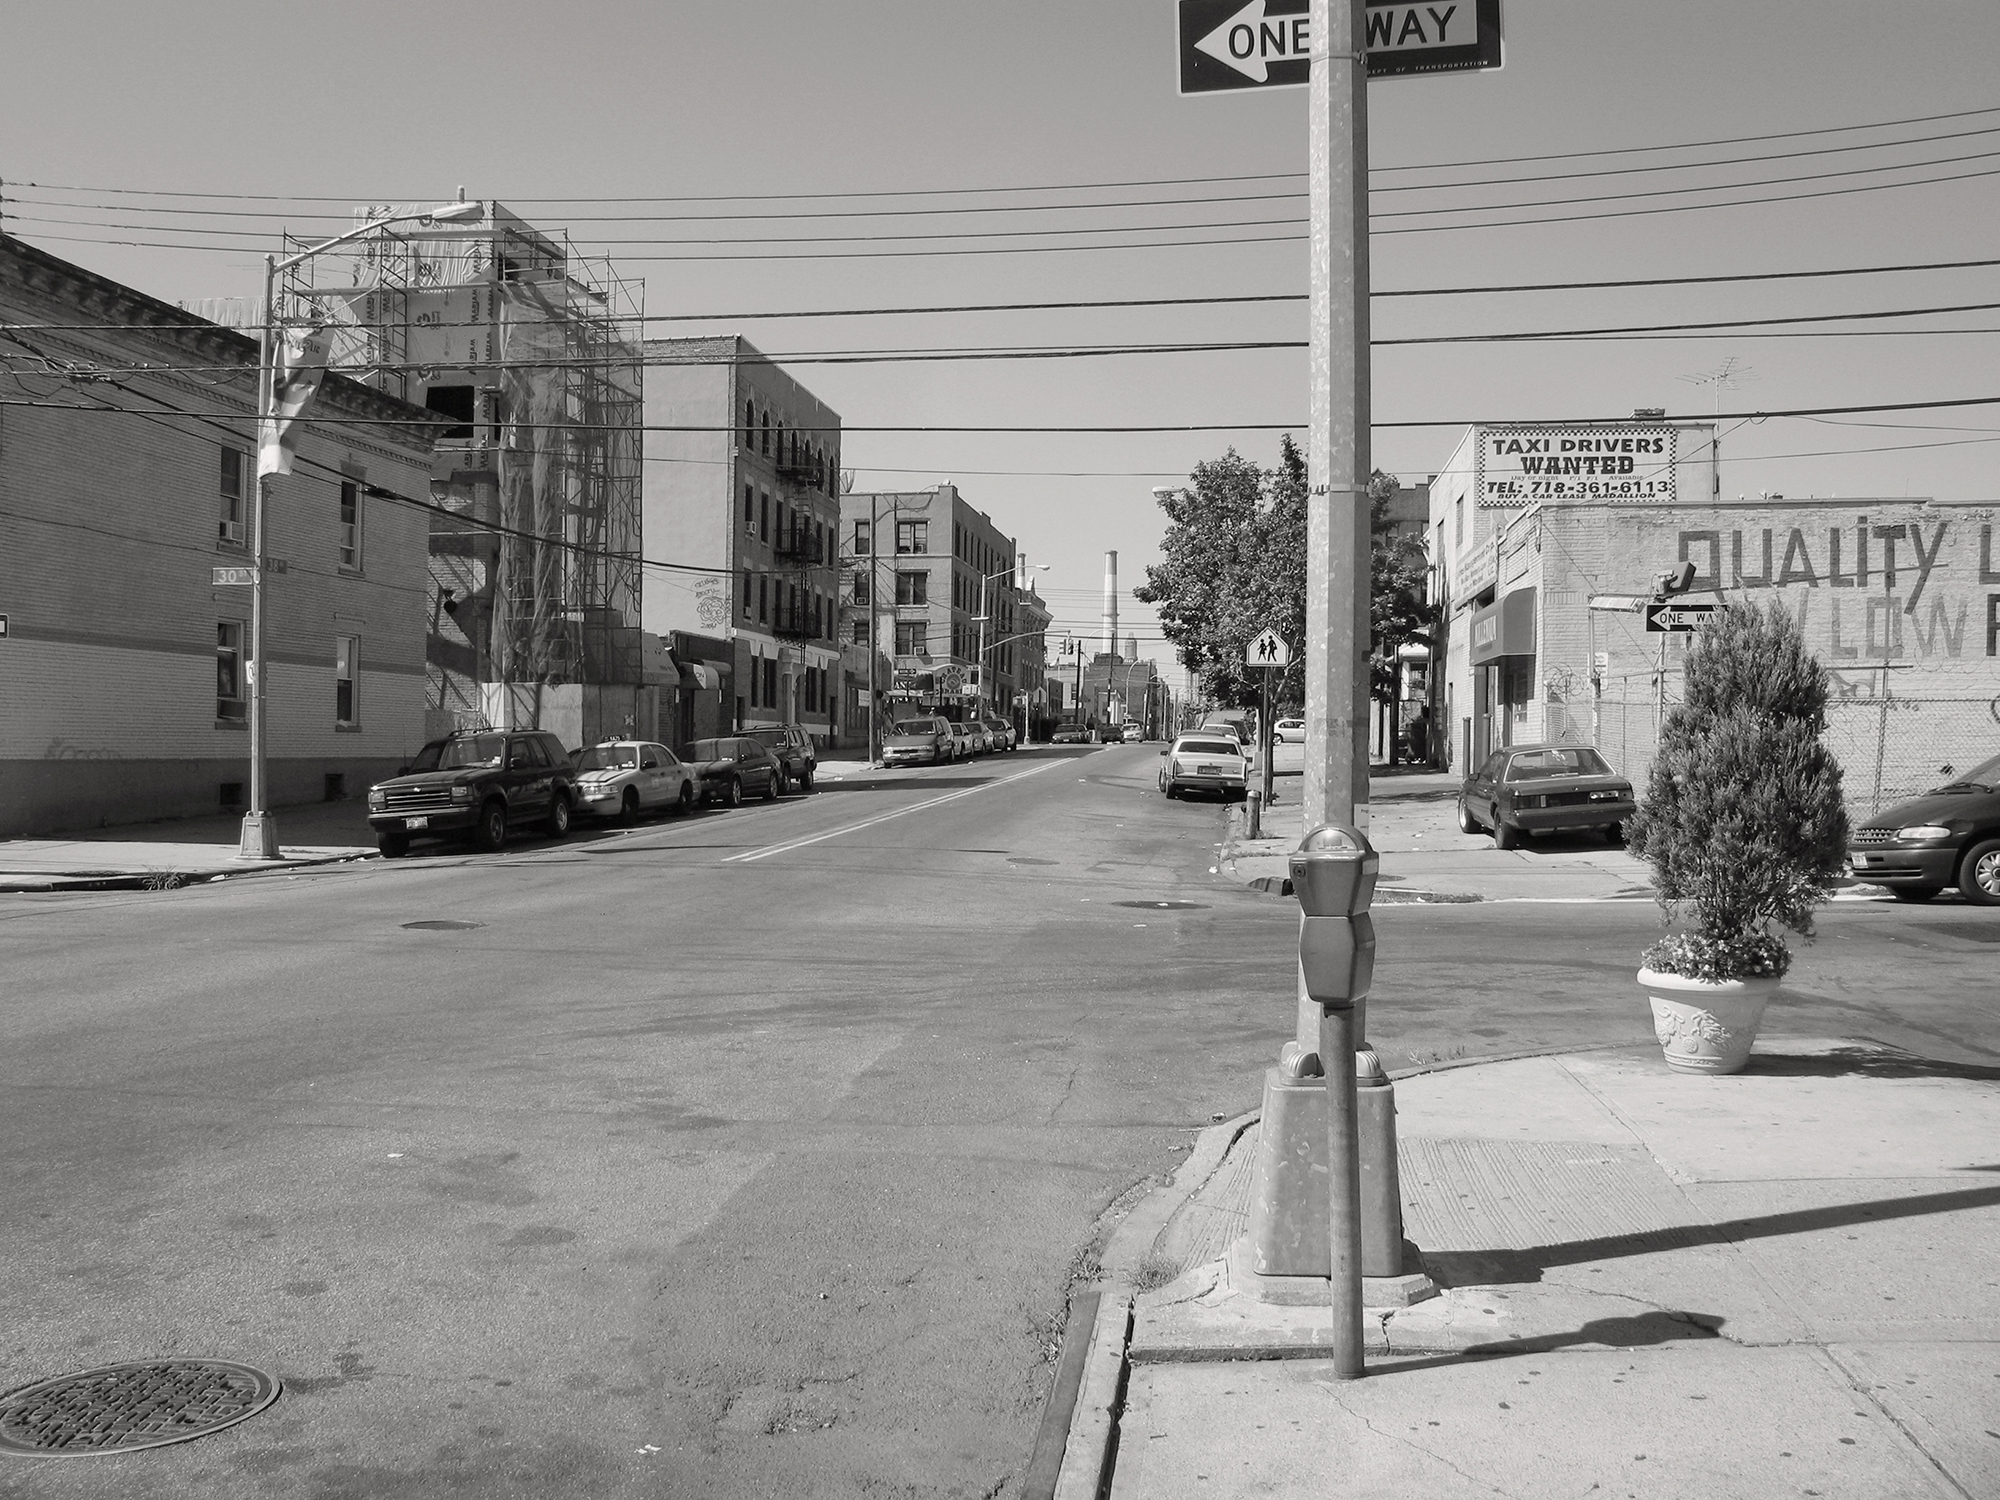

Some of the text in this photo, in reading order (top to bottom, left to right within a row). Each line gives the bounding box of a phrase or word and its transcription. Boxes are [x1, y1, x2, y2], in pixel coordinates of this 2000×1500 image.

[1228, 5, 1457, 60] ONE WAY
[1415, 60, 1489, 71] TRANSPORTATION
[1492, 438, 1664, 455] TAXI DRIVERS
[1520, 456, 1634, 475] WANTED
[1487, 481, 1668, 494] TEL: 718-361-6113
[1678, 516, 1948, 615] QUALITY
[219, 570, 237, 583] 30
[1660, 613, 1714, 624] ONE WA
